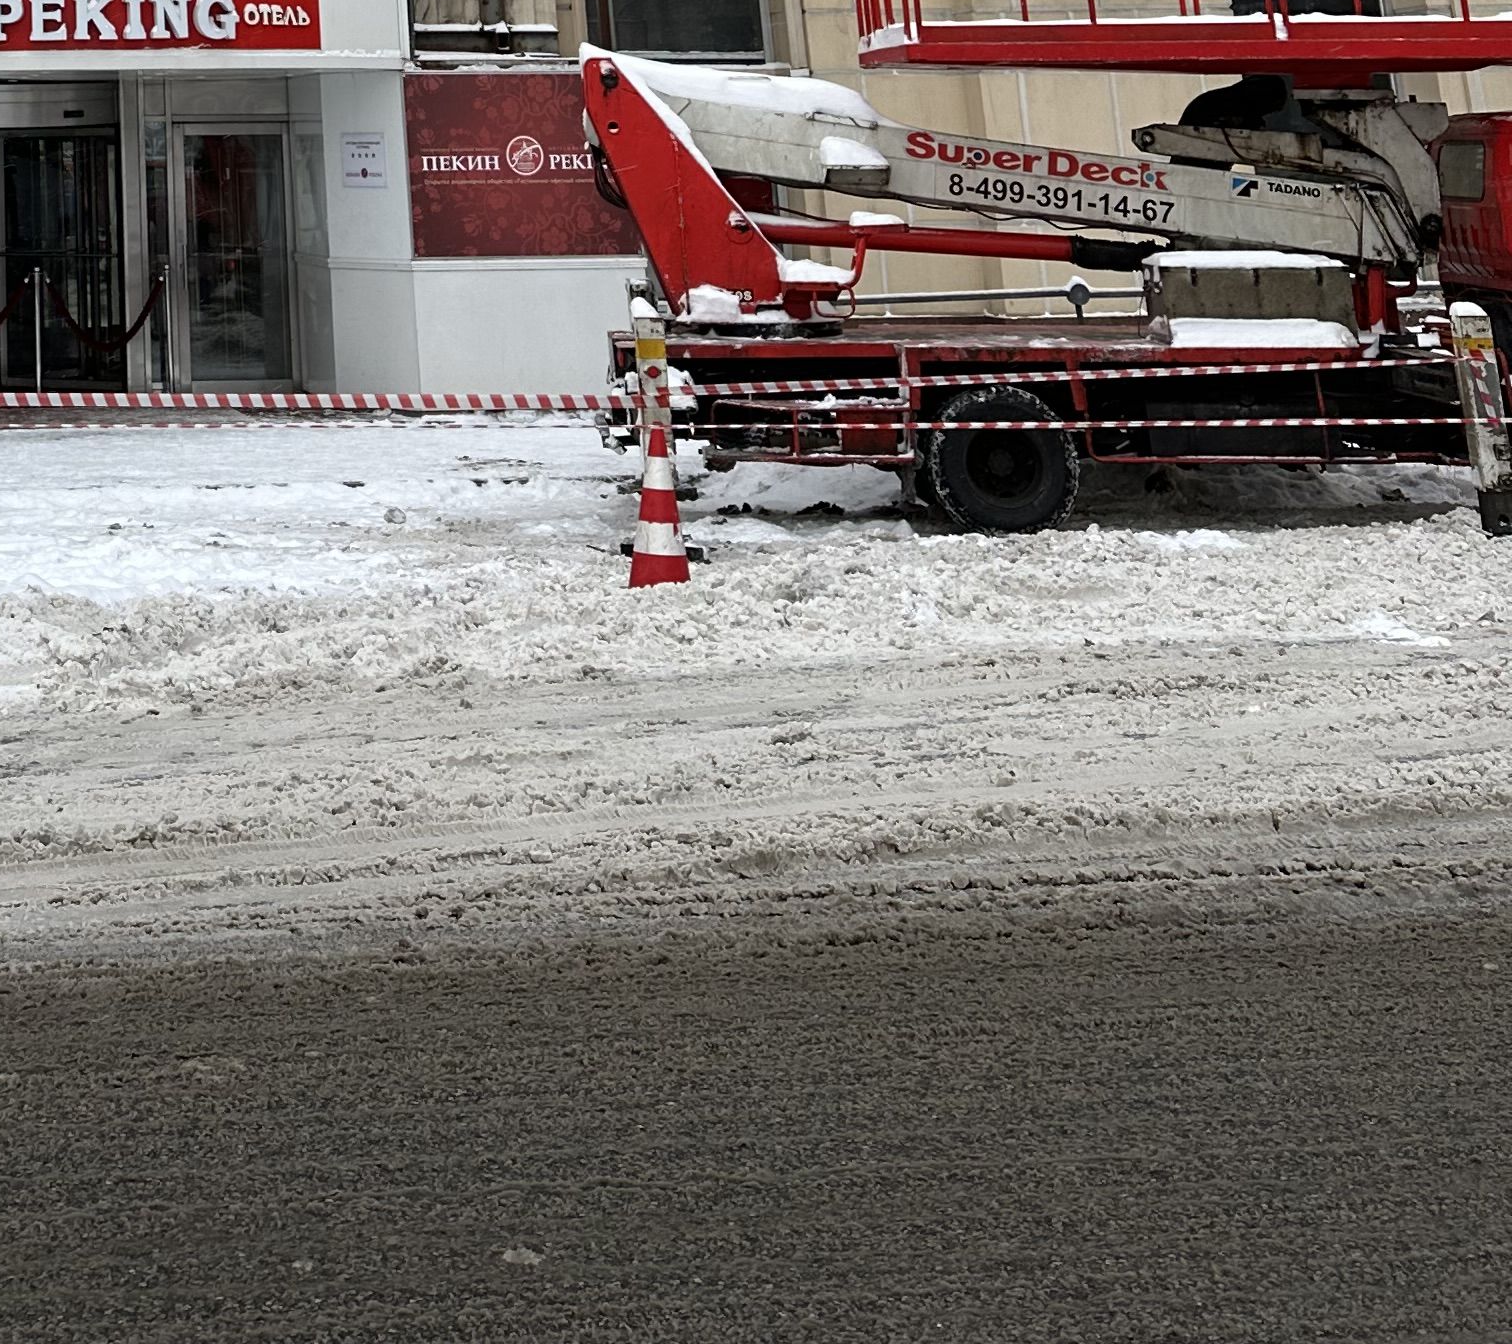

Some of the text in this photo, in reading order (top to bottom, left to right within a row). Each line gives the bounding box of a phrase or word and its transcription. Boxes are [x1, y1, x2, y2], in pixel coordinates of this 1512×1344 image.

[243, 2, 311, 27] ОТЕЛЬ
[421, 155, 501, 171] ПЕКИН
[548, 154, 594, 170] PEKI
[1266, 181, 1321, 198] TADANO
[948, 173, 1175, 224] 8-499-391-14-67
